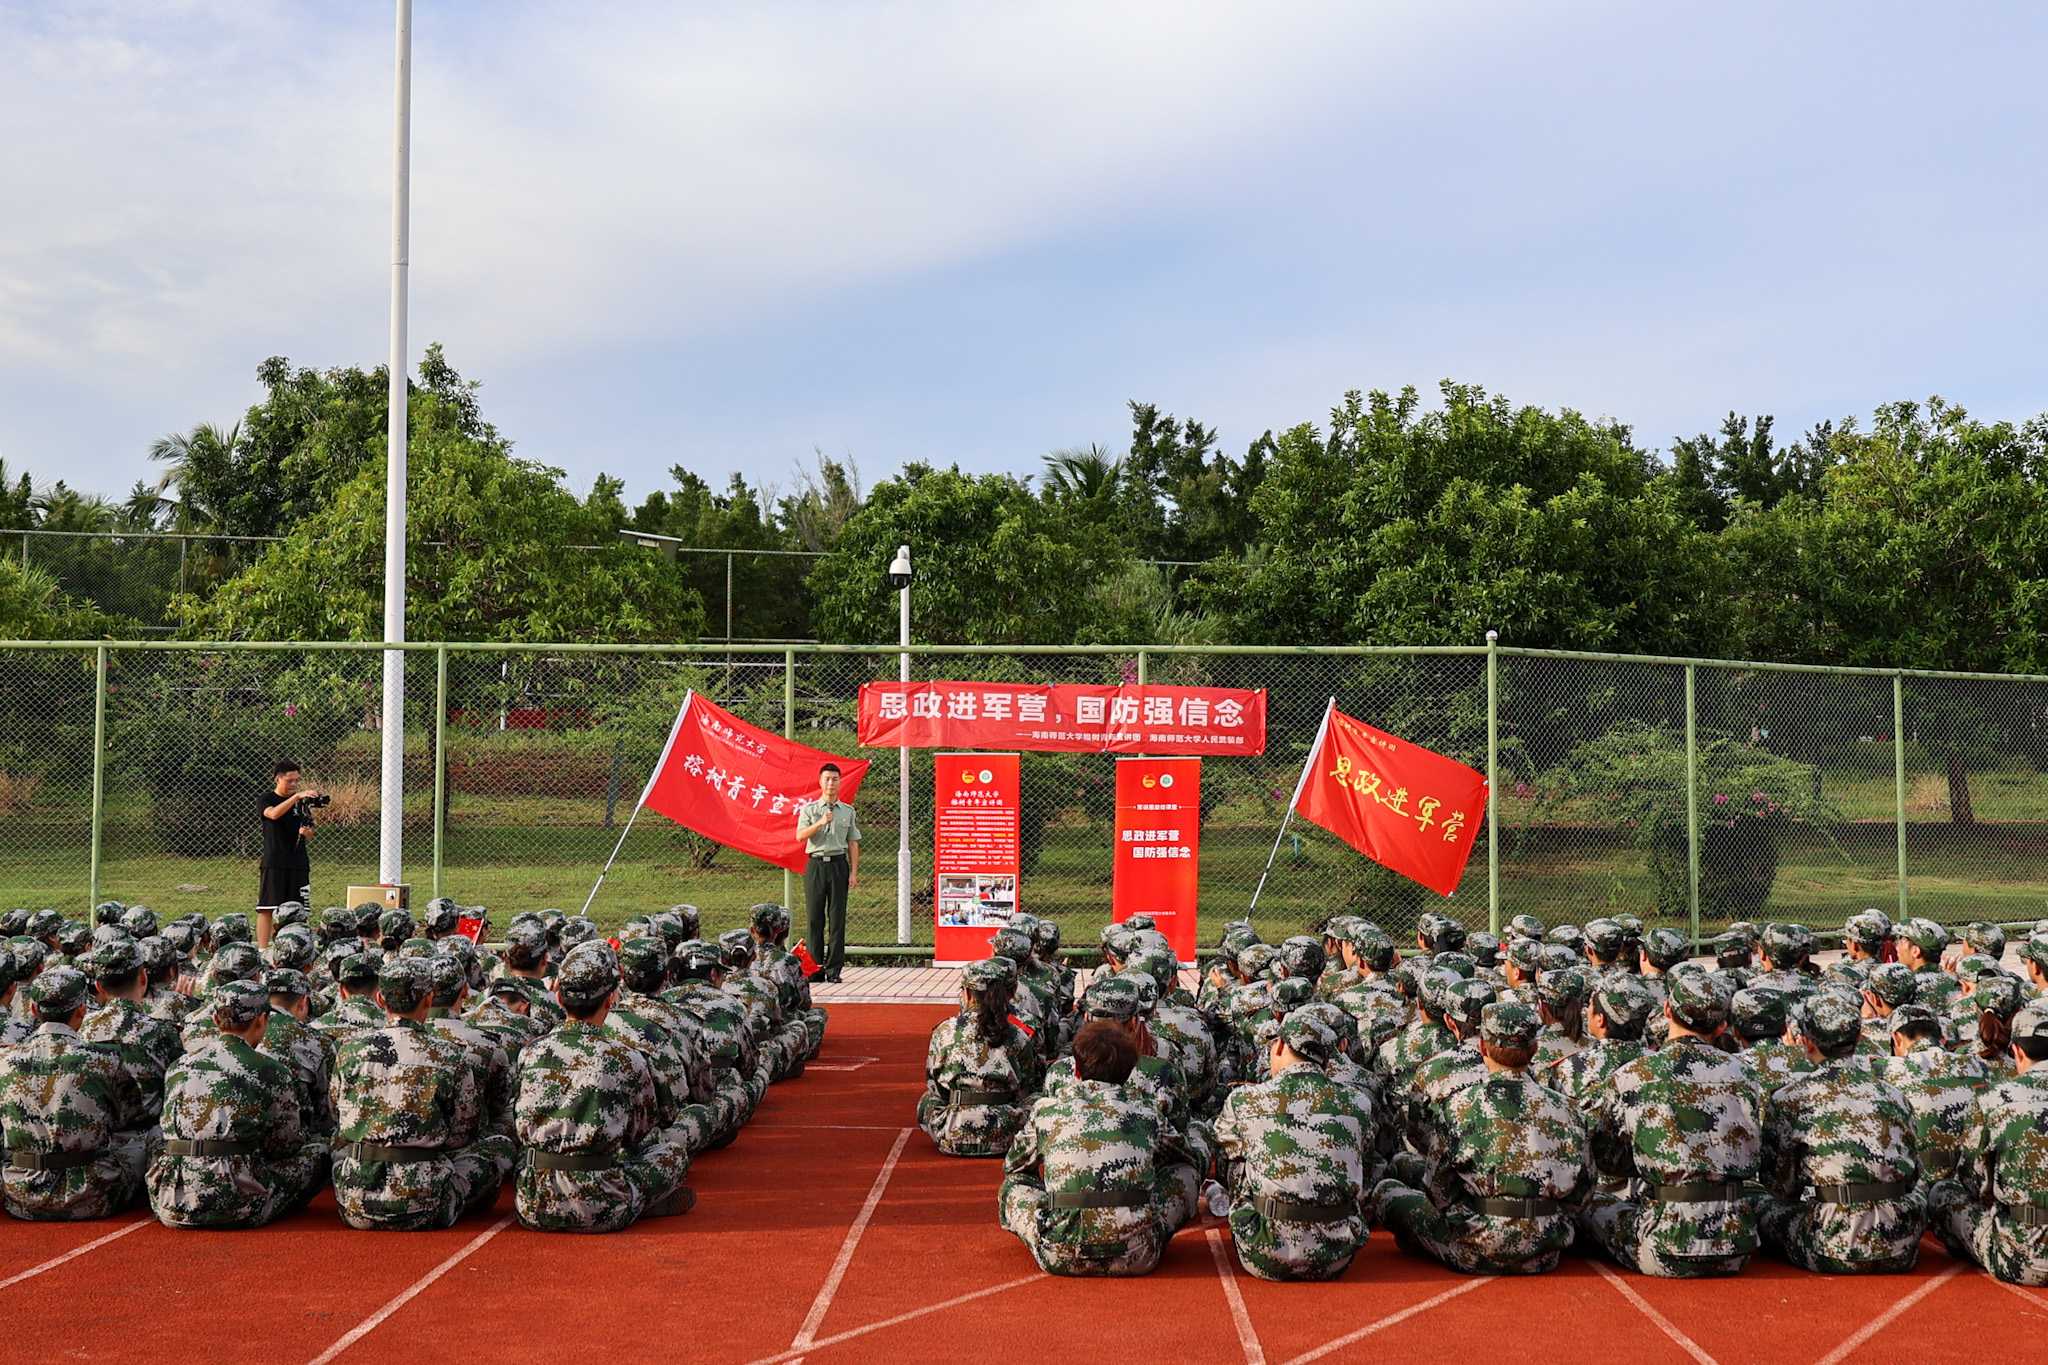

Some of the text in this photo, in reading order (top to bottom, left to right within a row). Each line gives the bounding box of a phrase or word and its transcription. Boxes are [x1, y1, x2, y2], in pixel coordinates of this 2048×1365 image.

[879, 691, 1245, 728] 思政进军营，国防强信念
[1329, 755, 1465, 843] 思政进军营
[1121, 830, 1180, 842] 思政进军营
[1132, 847, 1191, 858] 国防强信念
